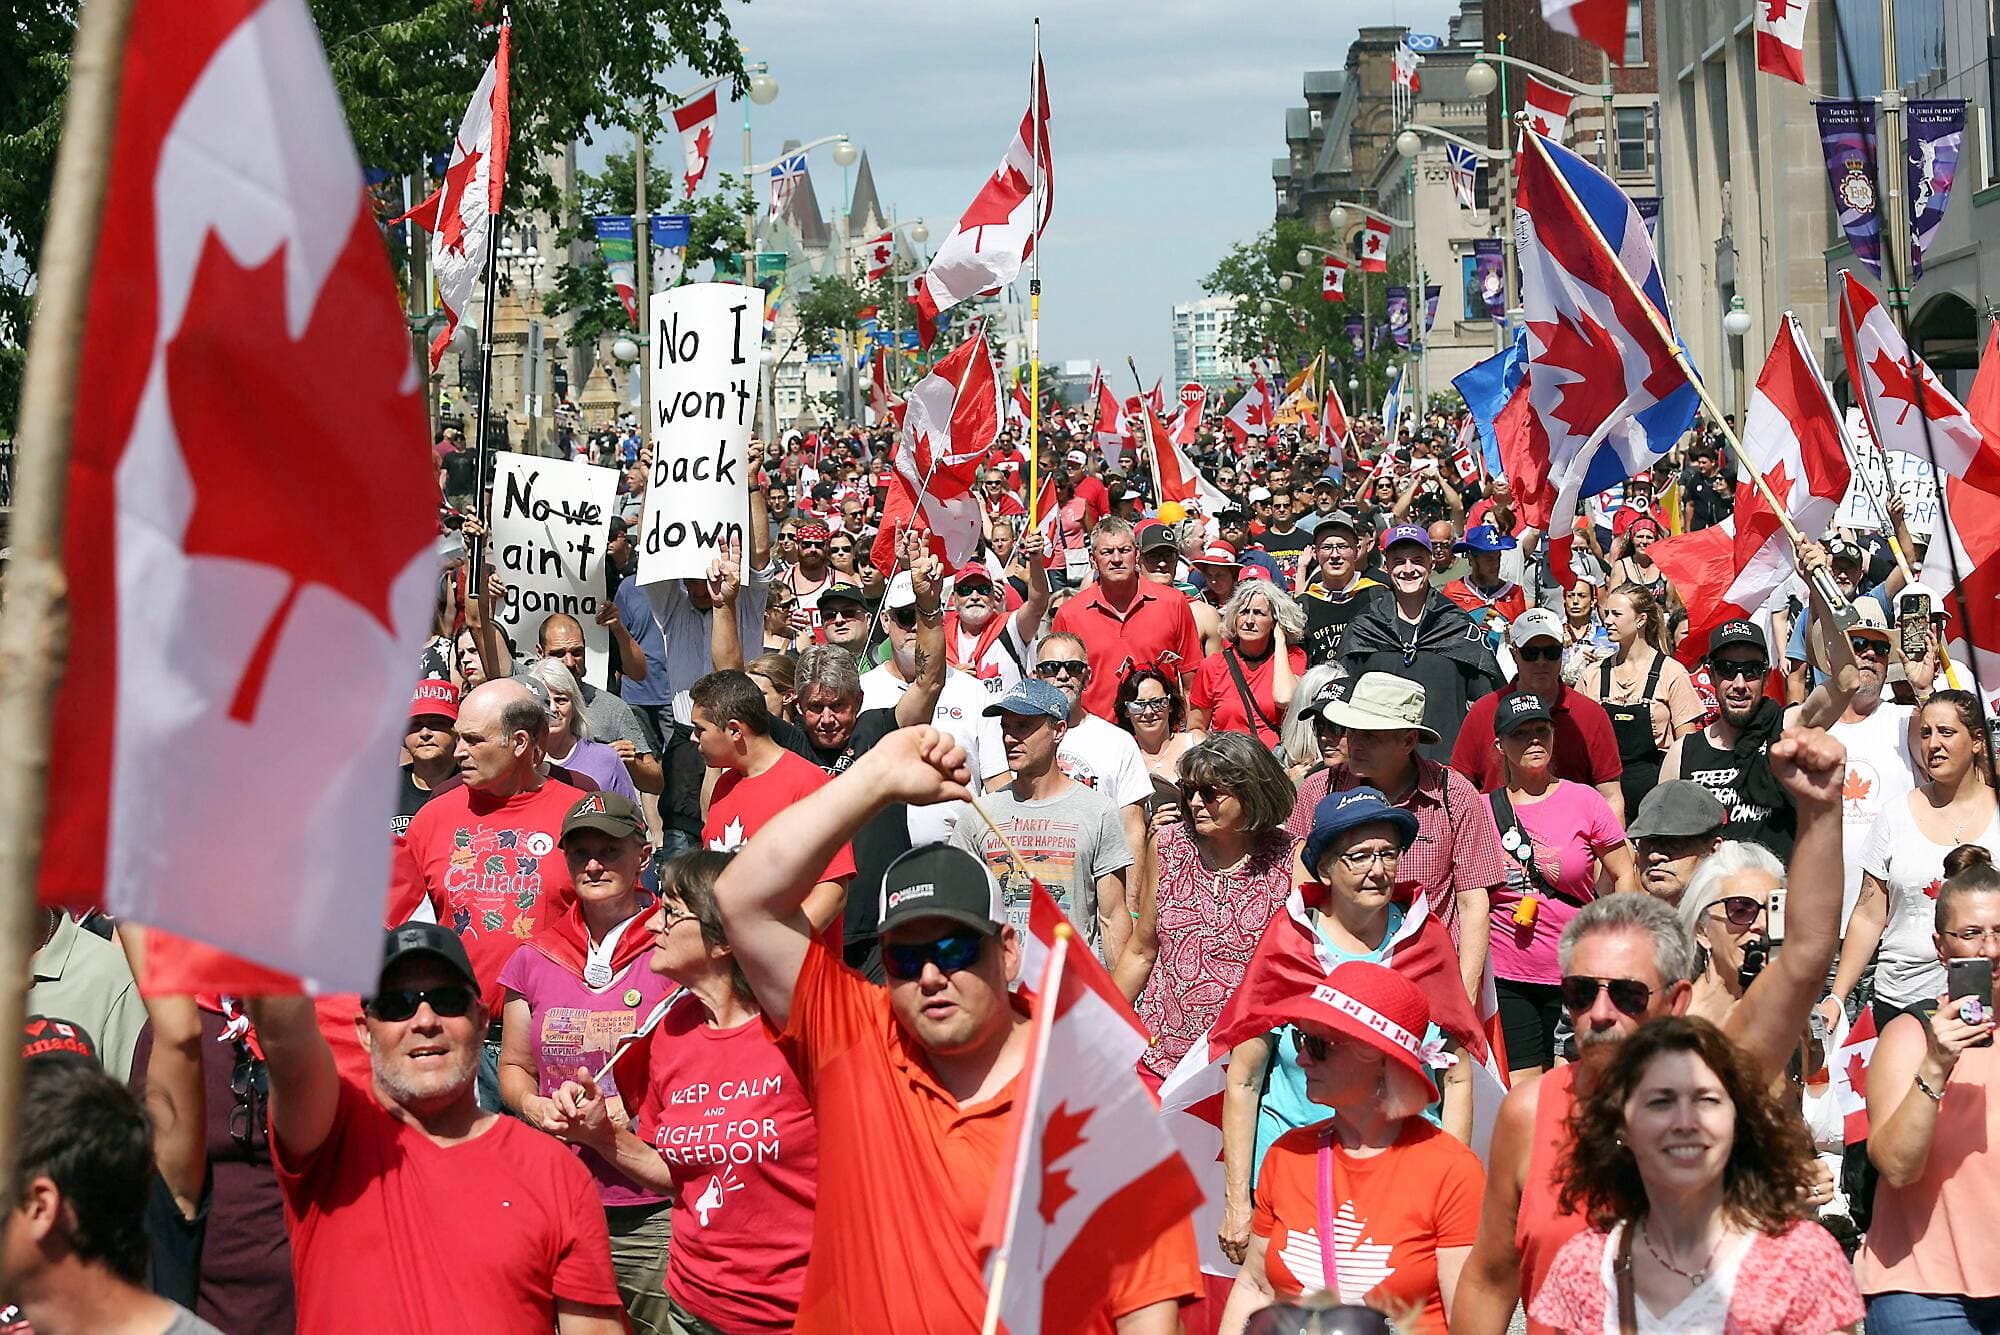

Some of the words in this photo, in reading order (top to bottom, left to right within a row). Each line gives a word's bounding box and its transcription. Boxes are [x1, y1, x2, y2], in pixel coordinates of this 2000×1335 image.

[659, 311, 699, 370] No
[729, 304, 748, 365] I
[658, 379, 751, 428] won't
[1181, 390, 1204, 401] STOP
[654, 439, 737, 489] back
[502, 470, 551, 522] No
[561, 500, 603, 525] we
[645, 510, 744, 555] down
[1395, 526, 1418, 538] PPC
[502, 534, 595, 582] ain't
[503, 584, 597, 625] gonna
[1313, 626, 1330, 640] OFF
[1721, 628, 1752, 638] TRUDEAU
[409, 685, 453, 704] ANADA
[1510, 696, 1521, 706] WE
[1527, 695, 1539, 704] THE
[1511, 700, 1542, 714] FRINGE
[1336, 792, 1377, 810] London
[1014, 817, 1051, 831] MARTY
[1035, 835, 1076, 849] HAPPENS
[444, 864, 543, 894] Canada
[21, 1037, 91, 1058] anada
[542, 1046, 577, 1056] CAMPING
[670, 1083, 710, 1105] KEEP
[718, 1074, 782, 1101] CALM
[703, 1106, 726, 1117] AND
[656, 1123, 720, 1145] FIGHT
[725, 1118, 779, 1140] FOR
